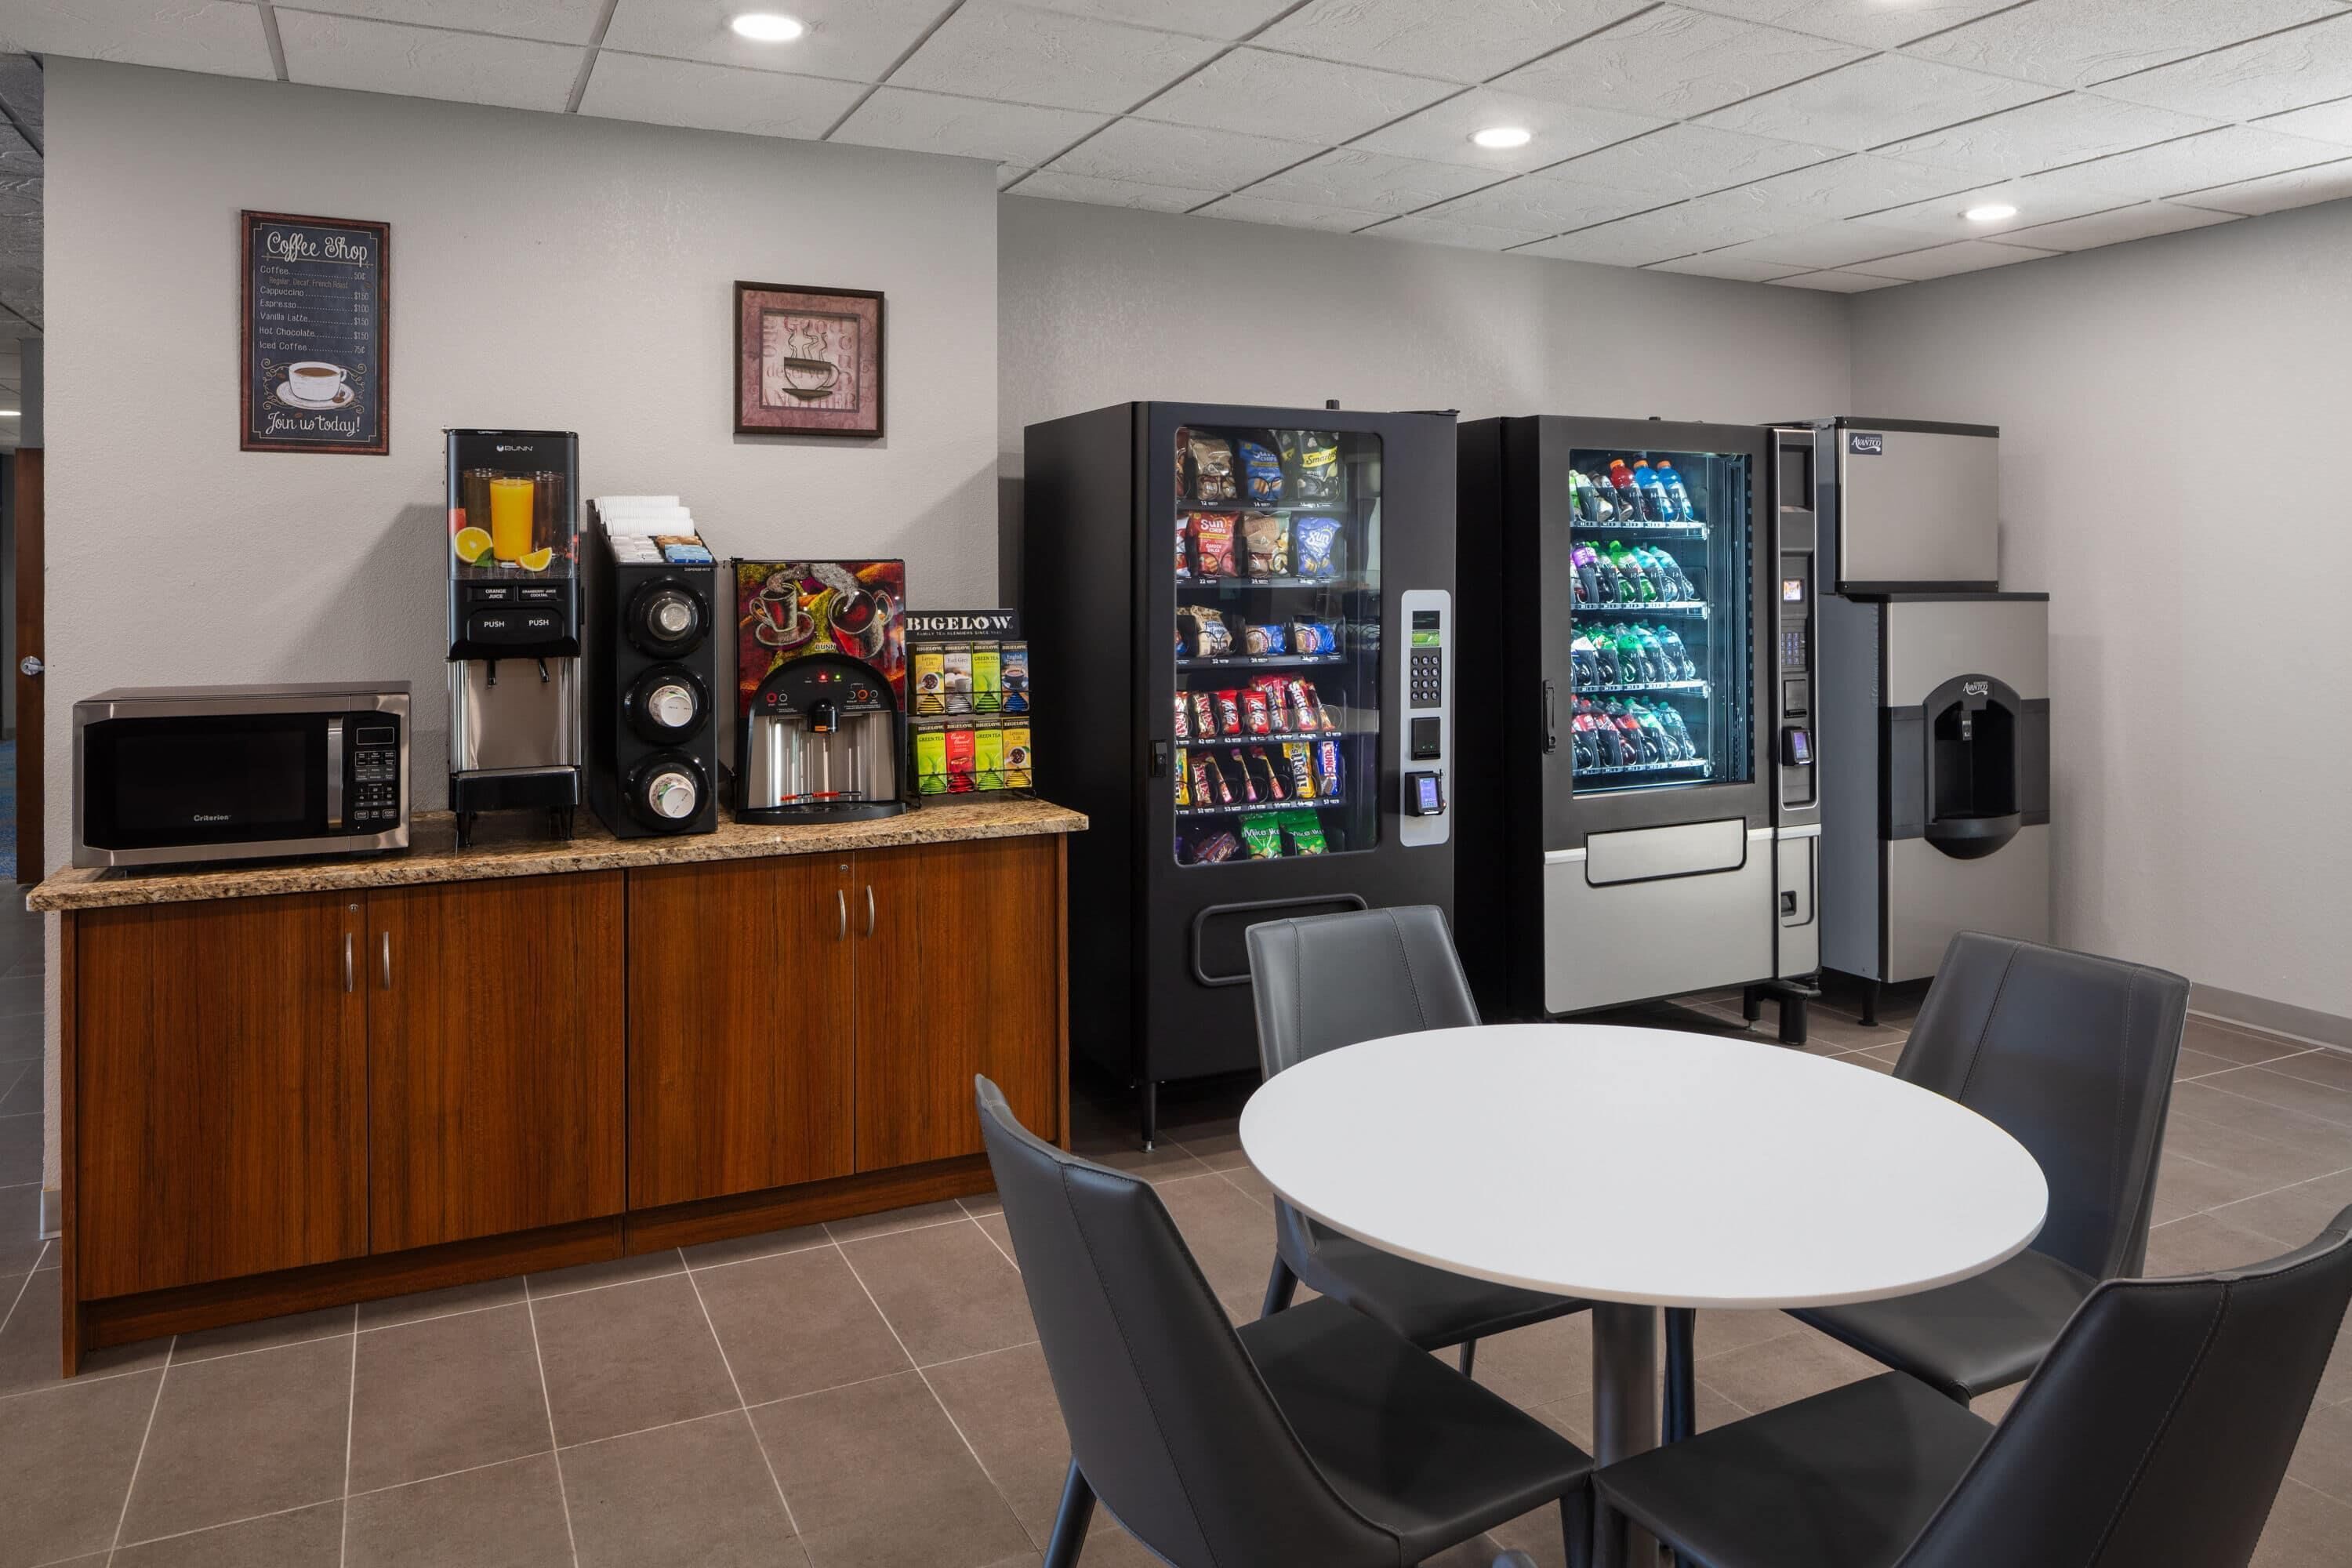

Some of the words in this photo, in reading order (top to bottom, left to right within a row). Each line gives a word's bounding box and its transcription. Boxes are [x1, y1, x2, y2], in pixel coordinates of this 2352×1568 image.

[267, 231, 320, 263] Coffee
[325, 236, 367, 267] Shop
[260, 266, 289, 275] Coffee
[260, 286, 304, 296] Cappuccino
[260, 299, 296, 308] Espresso
[260, 312, 285, 321] Vanilla
[287, 314, 308, 322] Latte
[259, 326, 273, 335] Hot
[276, 327, 314, 337] Chocolate
[260, 341, 276, 350] Iced
[279, 342, 307, 351] Coffee
[266, 411, 297, 434] Join
[300, 419, 314, 430] us
[314, 415, 360, 437] today!
[1200, 519, 1223, 530] Sun
[906, 616, 1012, 630] BIGELOW
